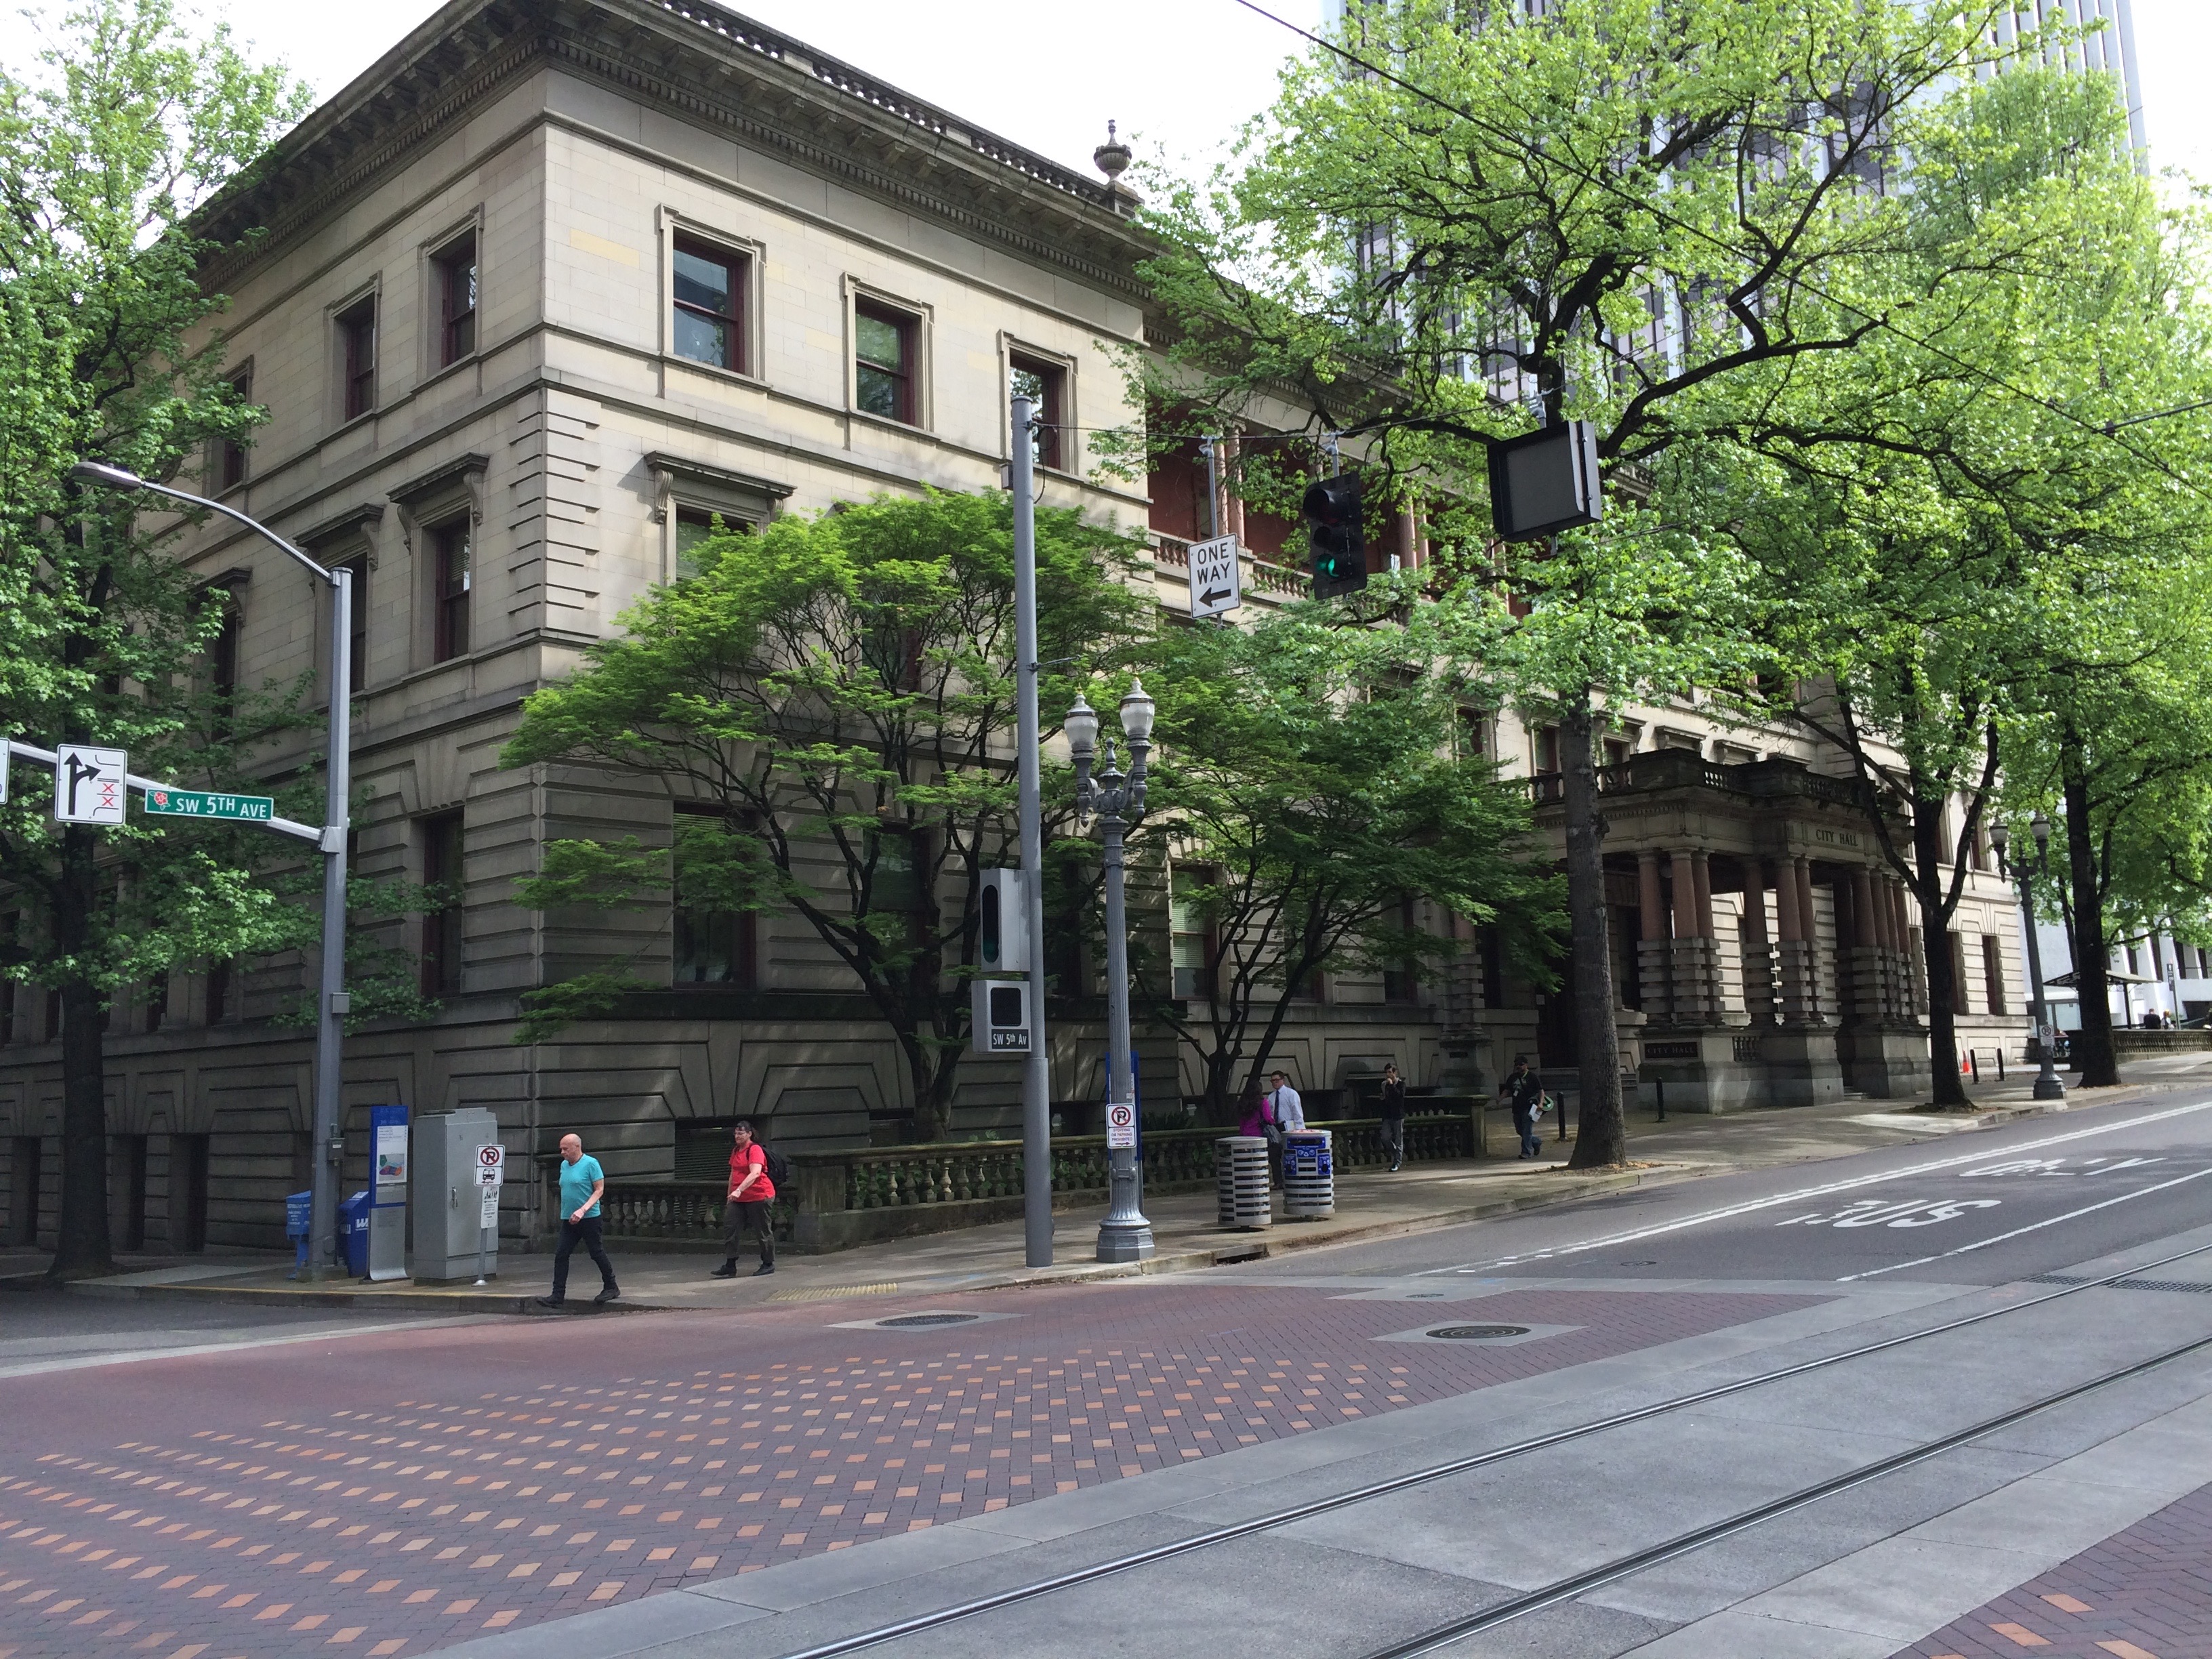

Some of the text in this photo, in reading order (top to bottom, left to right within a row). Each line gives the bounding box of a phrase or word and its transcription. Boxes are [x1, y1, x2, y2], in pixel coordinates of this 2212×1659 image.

[1197, 542, 1229, 565] ONE
[1197, 561, 1231, 585] WAY
[176, 796, 267, 818] SW 5TH AVE
[1816, 829, 1858, 846] CITY HALL
[993, 1033, 1027, 1045] SW 5th Av
